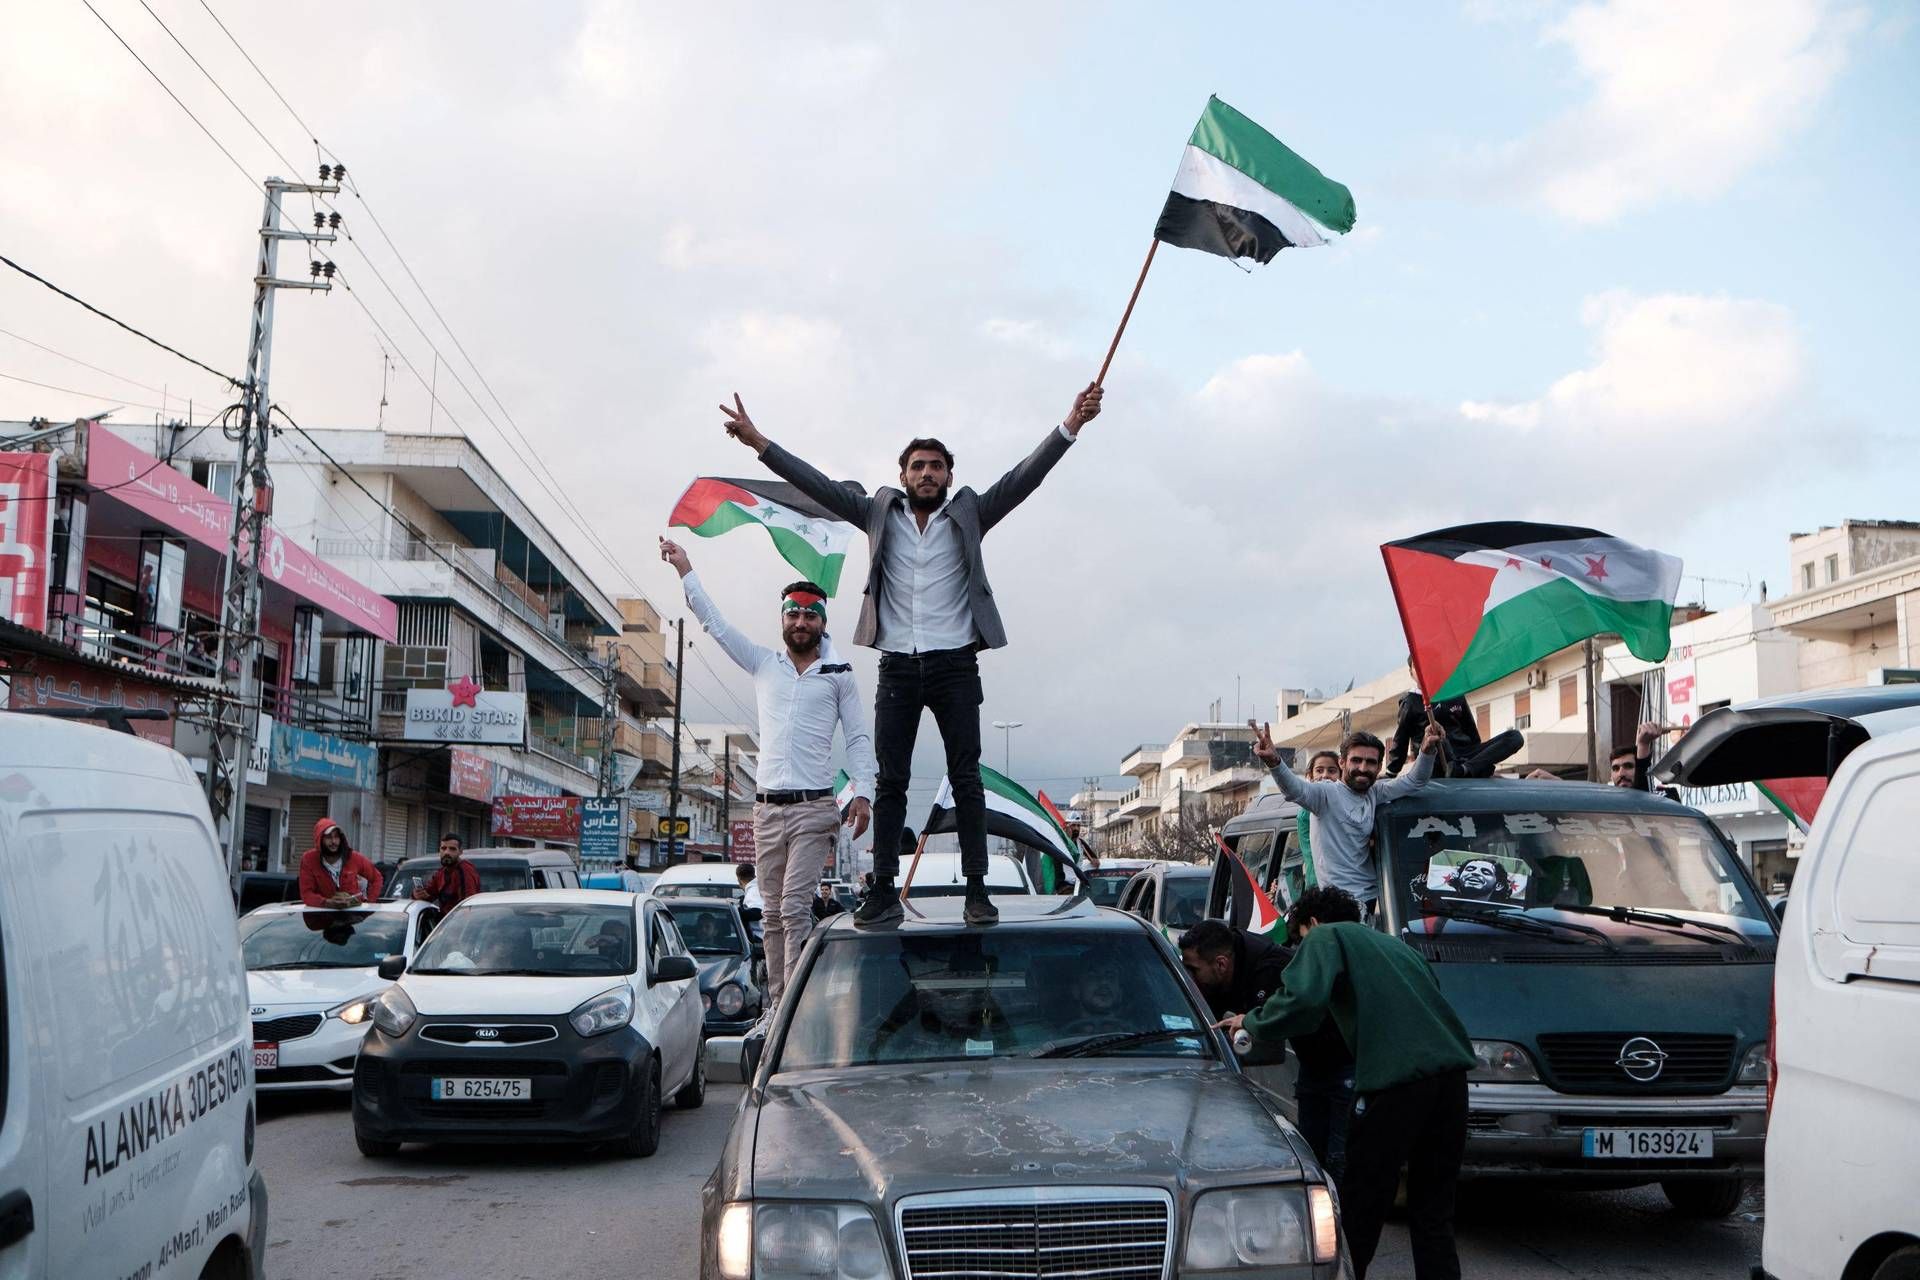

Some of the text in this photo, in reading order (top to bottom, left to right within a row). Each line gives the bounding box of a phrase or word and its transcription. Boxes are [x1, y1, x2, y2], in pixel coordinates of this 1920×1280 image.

[409, 706, 518, 726] BBKID STAR
[513, 798, 568, 811] المنزل الحديث
[585, 799, 619, 814] شركة
[583, 815, 619, 828] فارس
[393, 883, 404, 896] 2
[255, 1053, 277, 1067] 692
[445, 1080, 521, 1097] B 625475
[84, 1044, 247, 1186] ALANAKA 3DESIGN
[1600, 1132, 1700, 1155] M 163924
[206, 1201, 228, 1235] Main
[230, 1176, 247, 1216] Road
